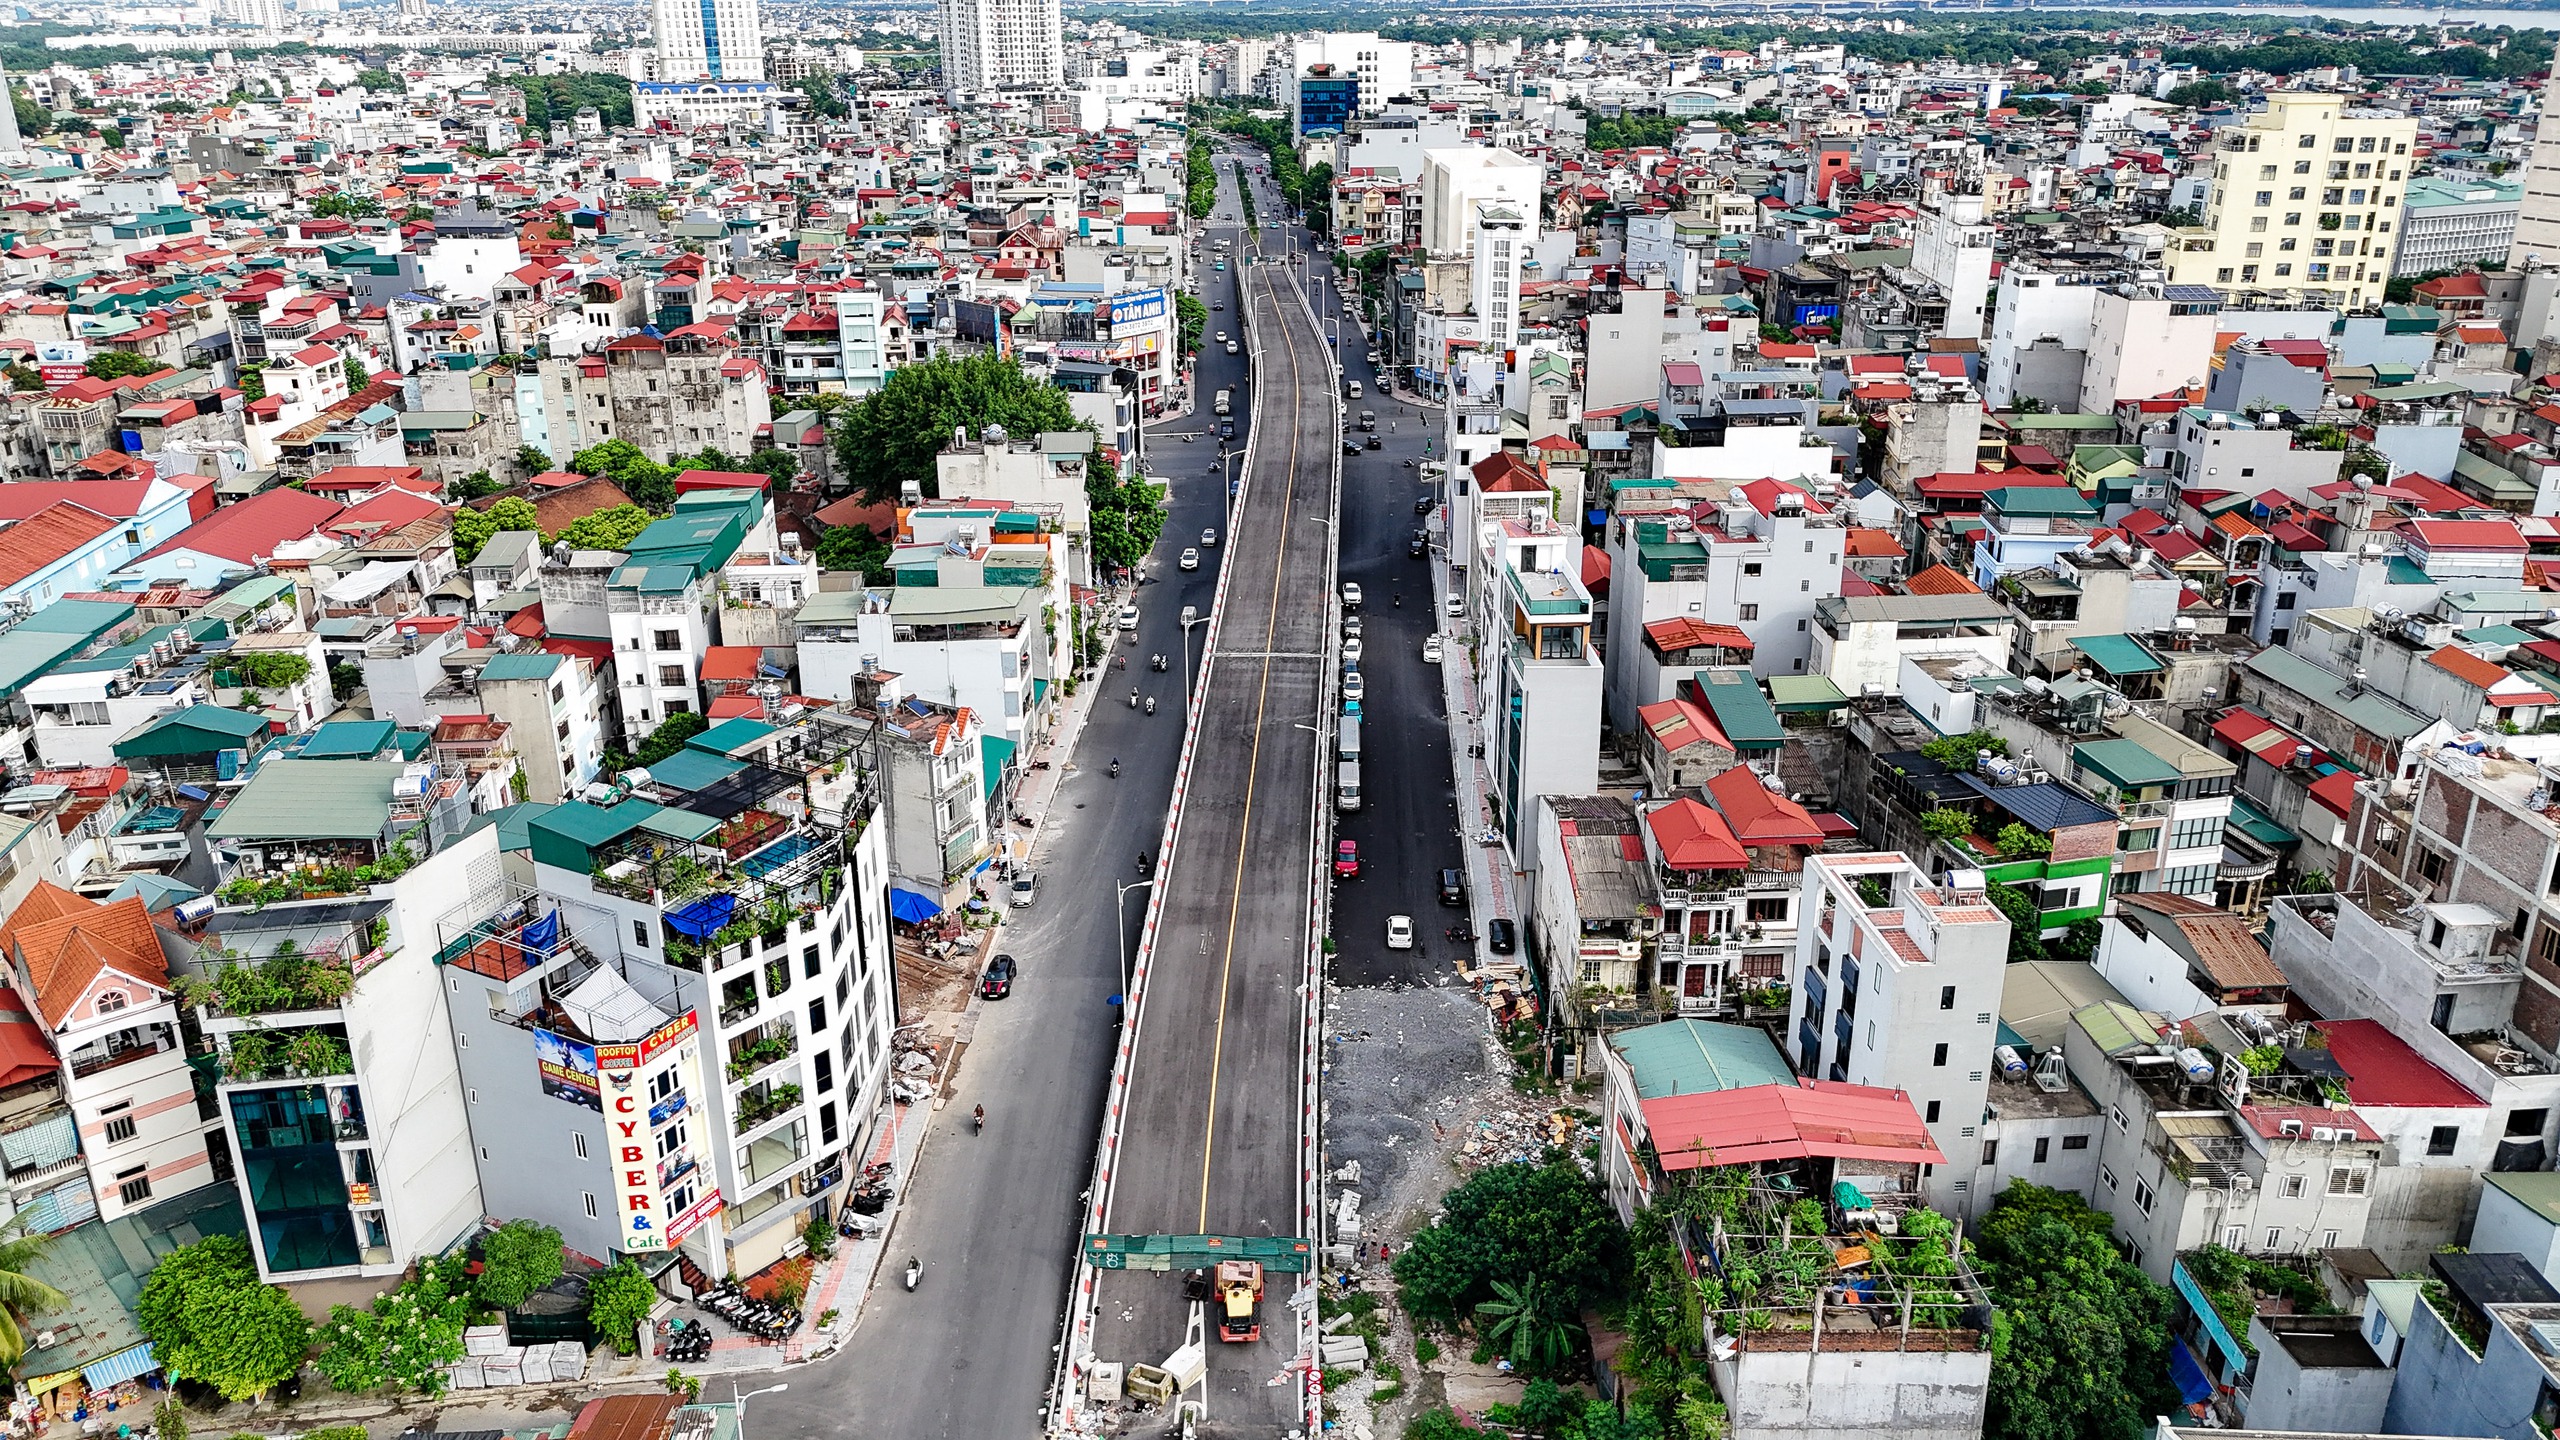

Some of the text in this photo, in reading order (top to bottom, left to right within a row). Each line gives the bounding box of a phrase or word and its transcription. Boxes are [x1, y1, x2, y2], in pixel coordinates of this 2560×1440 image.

[1122, 301, 1162, 321] TÂM ANH
[649, 1016, 689, 1048] CYBER
[597, 1046, 637, 1057] ROOFTOP
[602, 1058, 634, 1069] COFFEE
[542, 1061, 565, 1078] GAME
[565, 1068, 597, 1089] CENTER
[615, 1096, 651, 1210] CYBER
[632, 1215, 653, 1231] &
[627, 1234, 663, 1250] Cafe
